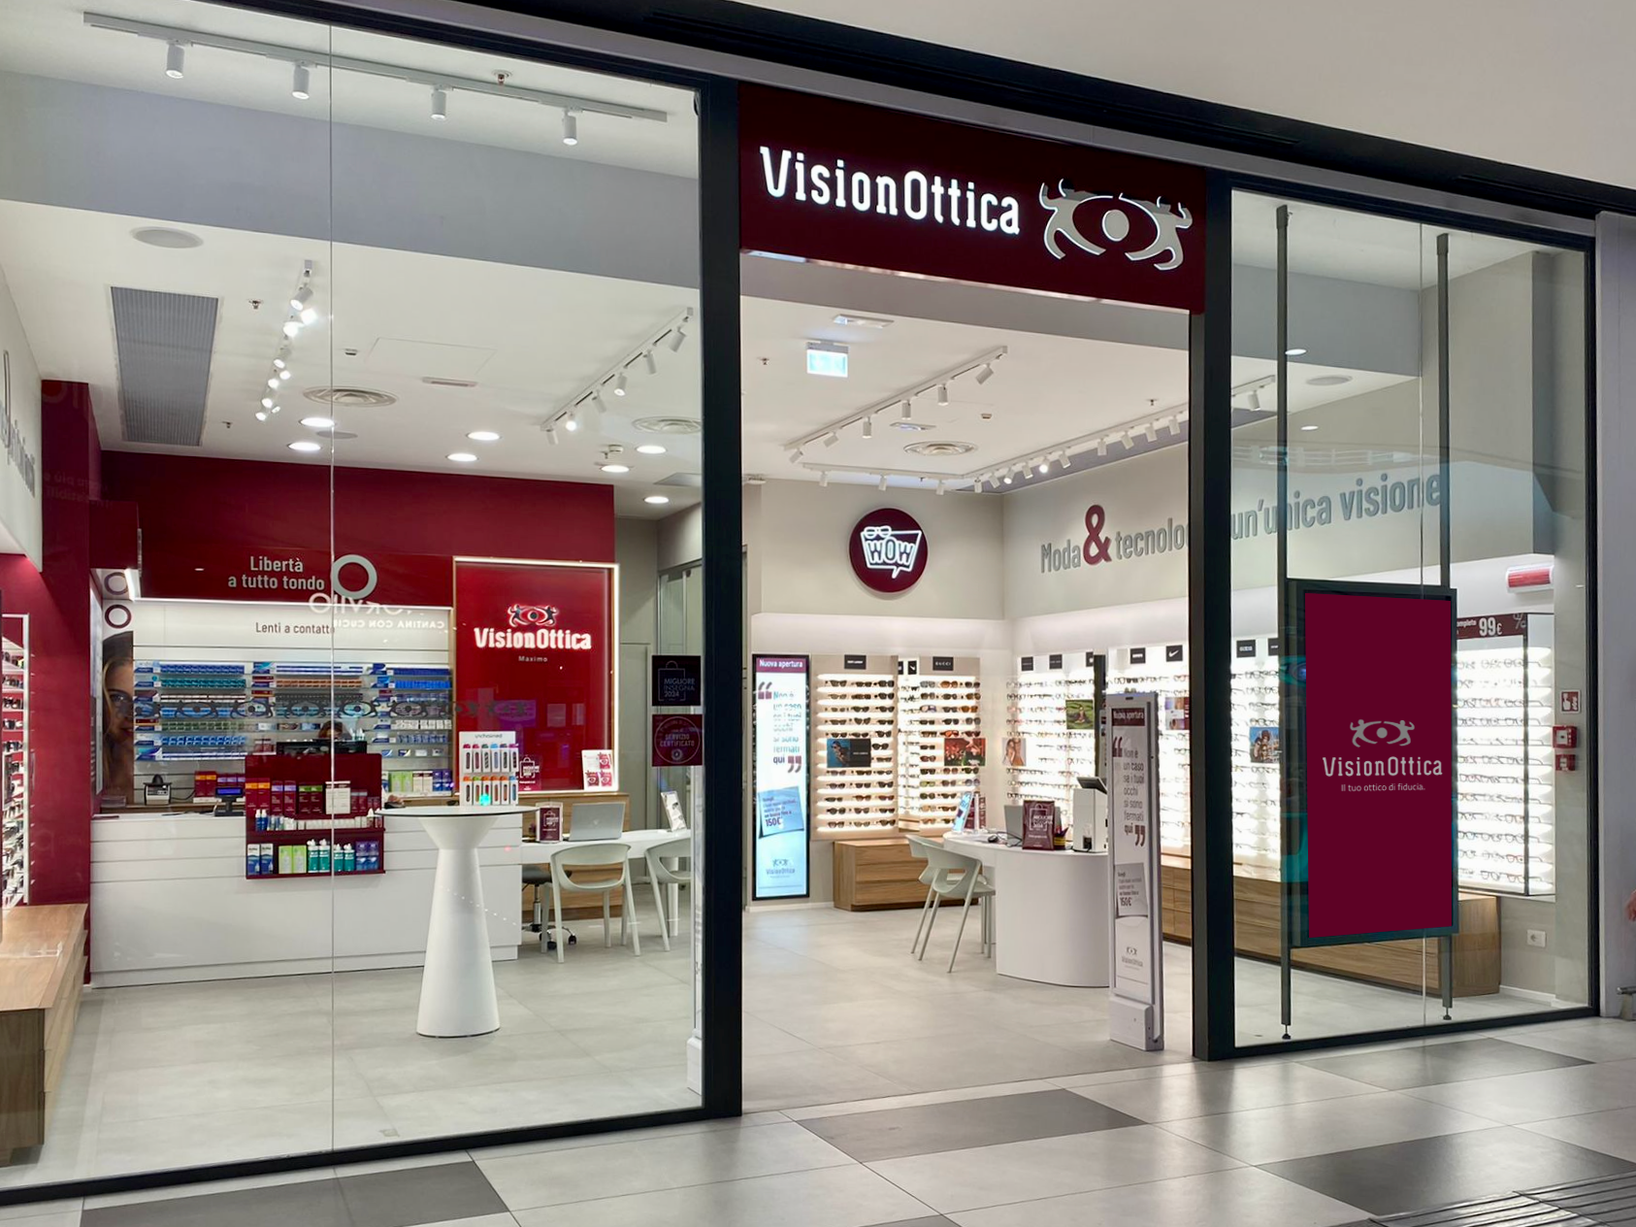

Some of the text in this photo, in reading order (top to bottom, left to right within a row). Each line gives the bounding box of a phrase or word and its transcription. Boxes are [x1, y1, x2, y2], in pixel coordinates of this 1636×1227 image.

[759, 145, 1021, 236] VisionOttica
[1040, 538, 1081, 574] Moda
[1082, 504, 1113, 567] &
[1114, 517, 1189, 561] tecnolo
[1339, 472, 1441, 521] visione
[865, 536, 916, 566] WOW
[249, 555, 304, 574] Libertà
[227, 573, 325, 591] a tutto tondo
[255, 621, 281, 634] Lenti
[284, 625, 291, 634] a
[473, 627, 592, 650] VisionOttica
[518, 655, 548, 663] Maximo
[759, 659, 803, 669] Nuova apertura
[773, 753, 785, 765] qui
[1321, 756, 1443, 777] VisionOttica
[1340, 782, 1426, 792] Il tuo ottico di fiducia.
